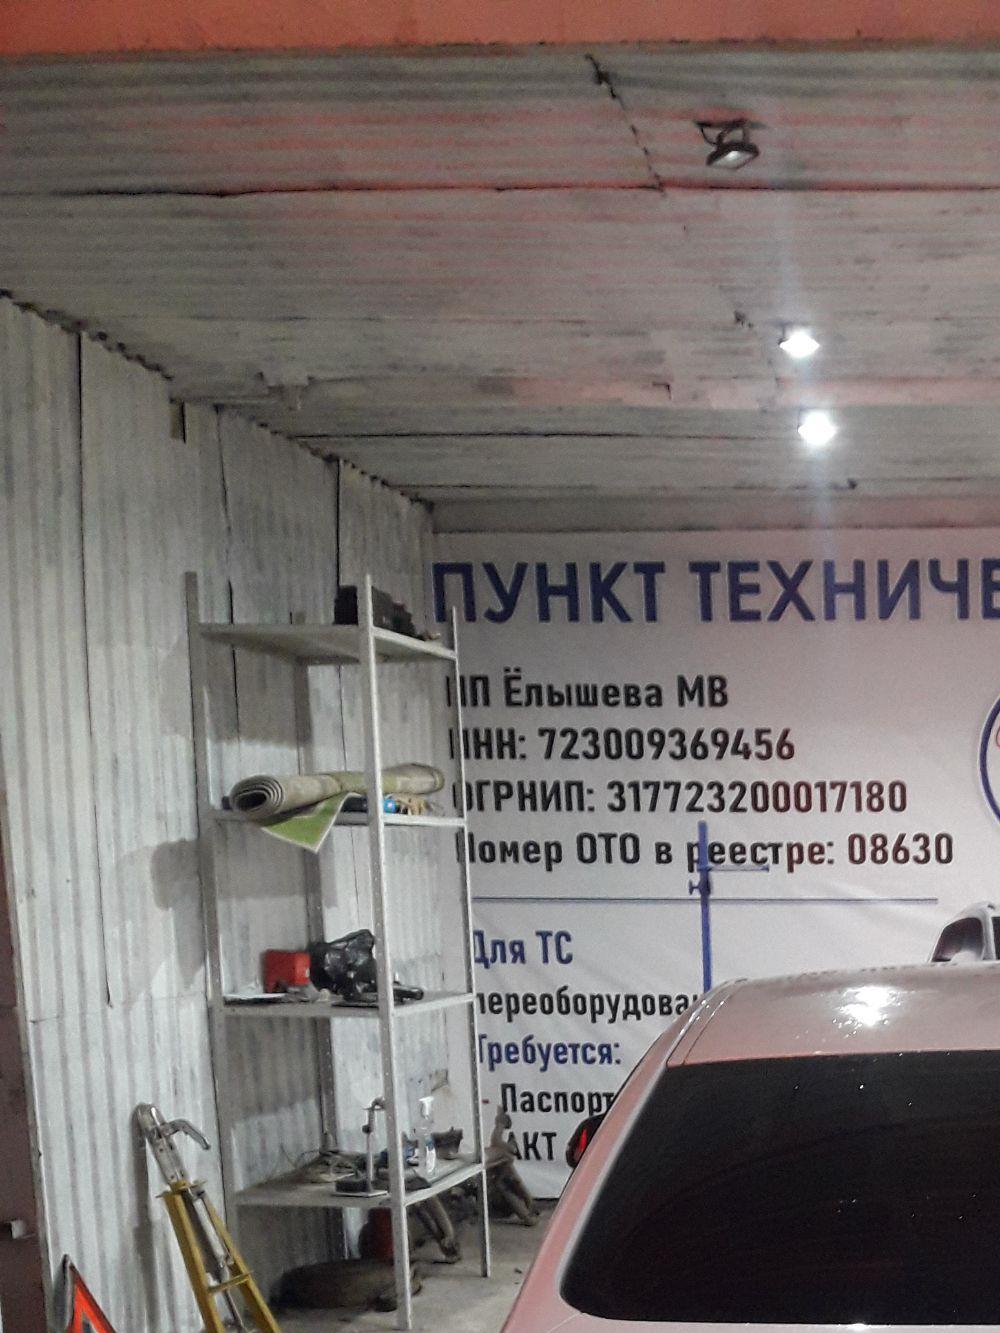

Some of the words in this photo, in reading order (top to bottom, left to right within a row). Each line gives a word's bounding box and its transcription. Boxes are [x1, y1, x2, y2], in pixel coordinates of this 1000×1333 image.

[432, 561, 666, 624] ПУНКТ
[445, 674, 490, 708] ИП
[503, 666, 663, 708] Ёлышева
[677, 674, 729, 707] МВ
[449, 728, 528, 760] ИНН:
[538, 728, 796, 761] 723009369456
[452, 780, 595, 812] ОГРНИП:
[606, 779, 908, 814] 317723200017180
[455, 832, 564, 872] Номер
[576, 832, 641, 866] ОТО
[655, 842, 673, 865] в
[686, 840, 834, 872] реестре:
[847, 833, 954, 866] 08630
[473, 929, 527, 970] Для
[535, 929, 574, 965] ТС
[475, 984, 701, 1025] ереоборудова
[478, 1034, 622, 1073] Требуется:
